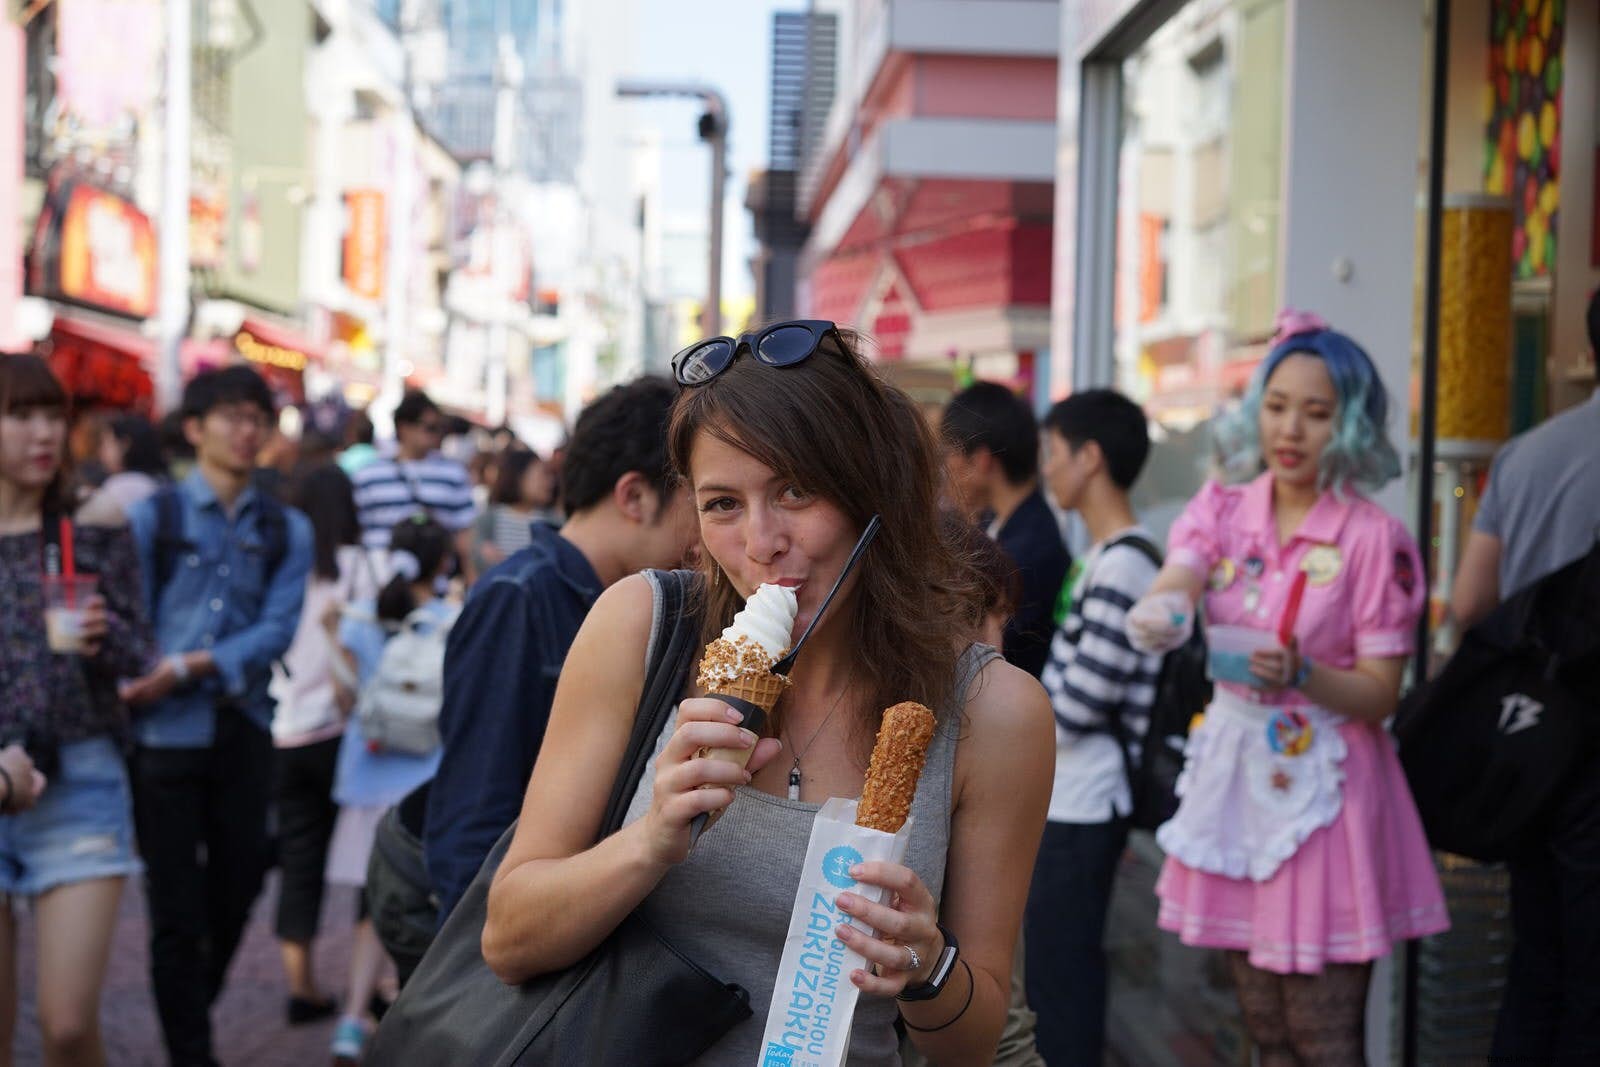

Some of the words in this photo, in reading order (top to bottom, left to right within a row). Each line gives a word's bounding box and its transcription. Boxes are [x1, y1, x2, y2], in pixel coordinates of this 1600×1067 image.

[782, 892, 836, 1052] ZAKUZAKU
[819, 908, 853, 1003] RQUANT
[807, 1003, 832, 1056] CHOU
